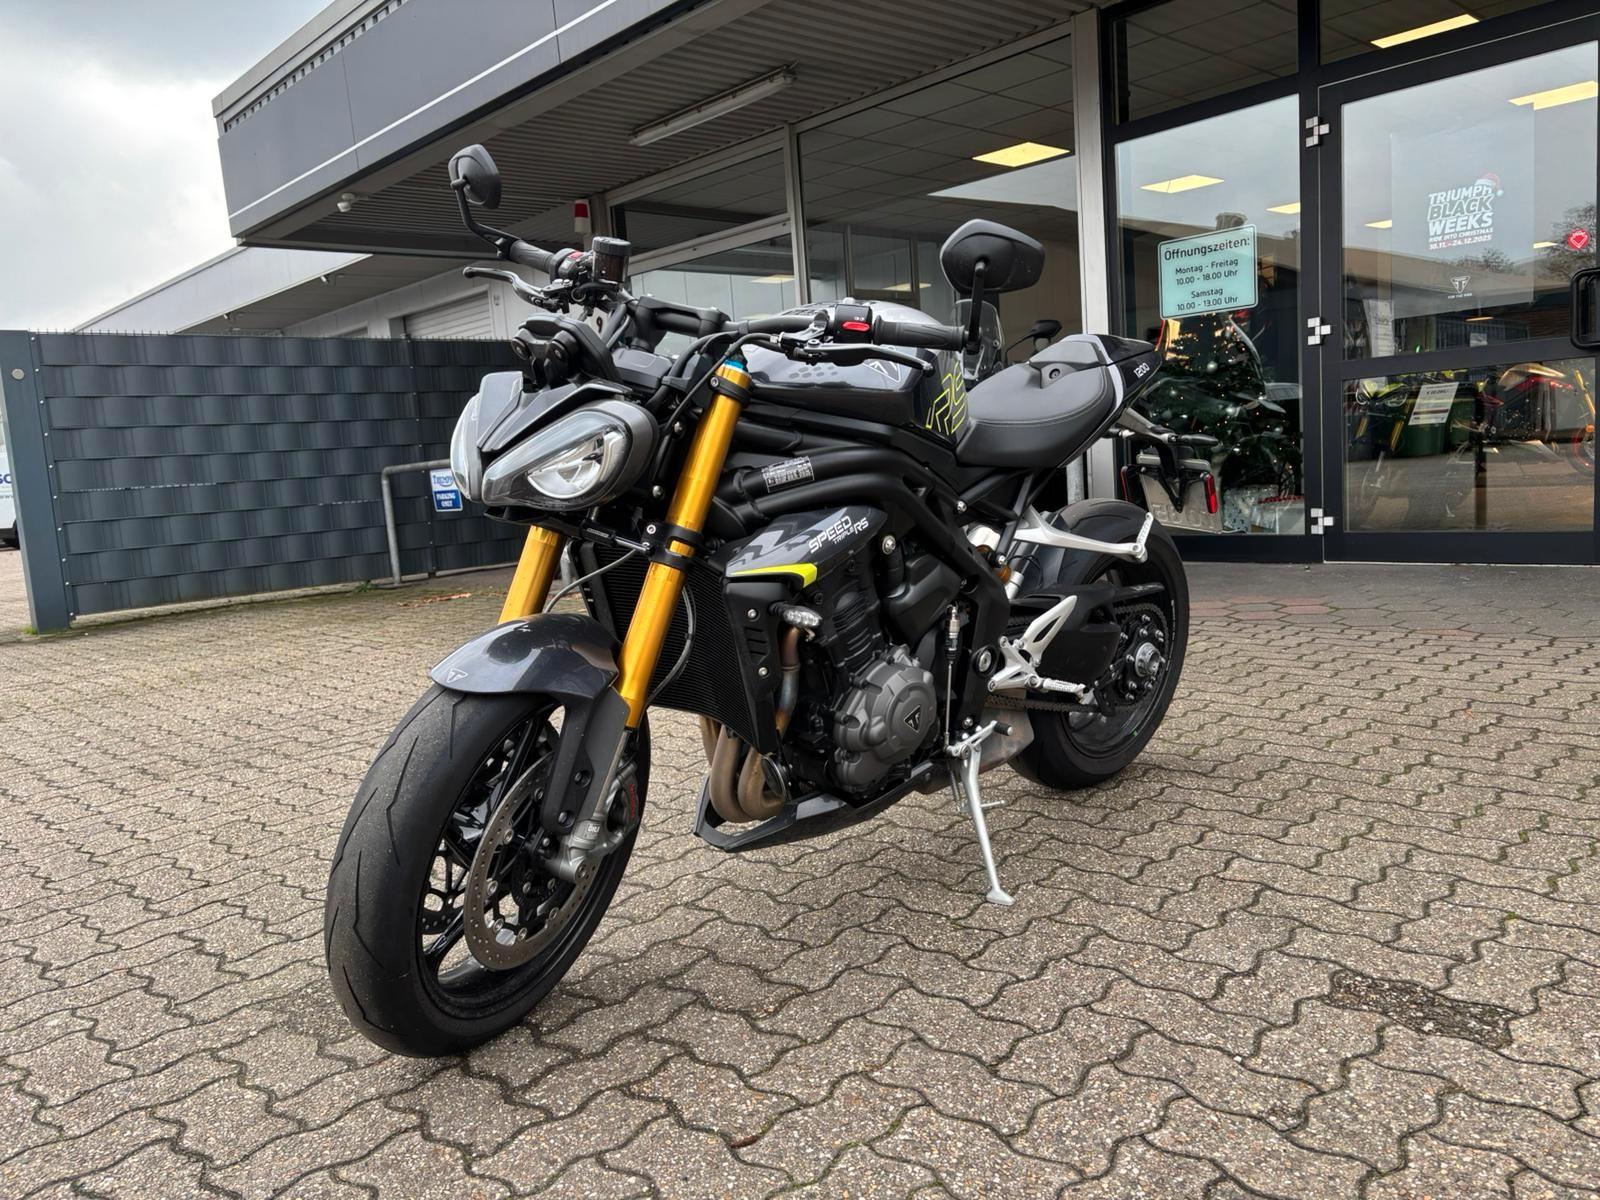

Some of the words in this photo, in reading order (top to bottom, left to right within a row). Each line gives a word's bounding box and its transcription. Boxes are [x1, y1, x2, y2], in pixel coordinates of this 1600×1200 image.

[1427, 194, 1495, 222] BLACK
[1428, 212, 1493, 236] WEEKS
[1443, 233, 1458, 241] INTO
[1458, 227, 1494, 238] CHRISTMAS
[1164, 237, 1250, 261] Öffnungszeiten:
[1175, 264, 1203, 275] Montag
[1211, 258, 1239, 270] Freitag
[1176, 276, 1195, 286] 10.00
[1202, 271, 1222, 281] 18.00
[1223, 269, 1238, 278] Uhr
[1191, 288, 1224, 299] Samstag
[1177, 302, 1196, 311] 10.00
[1203, 298, 1222, 307] 13.00
[1224, 296, 1239, 305] Uhr
[1133, 362, 1150, 378] 1200
[808, 515, 852, 554] SPEED
[832, 526, 855, 545] TRIPLE
[854, 517, 869, 534] RS
